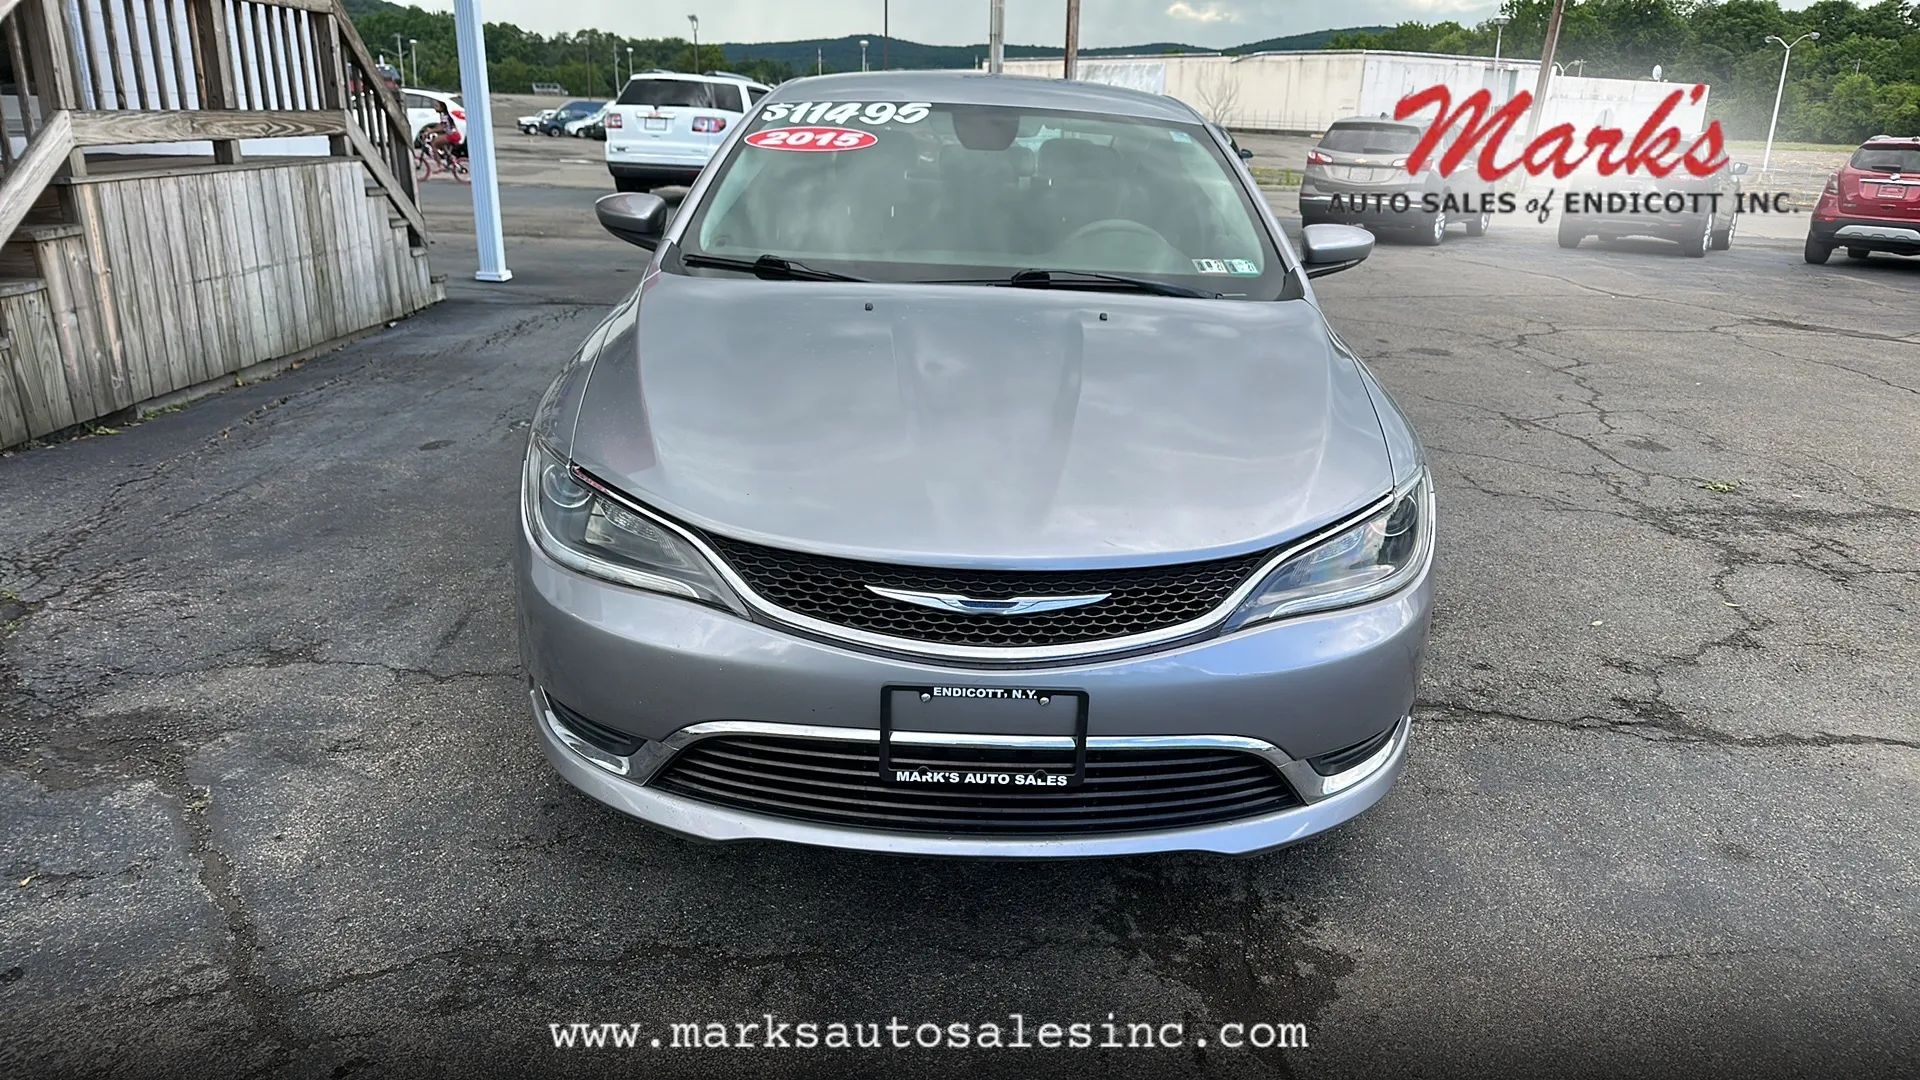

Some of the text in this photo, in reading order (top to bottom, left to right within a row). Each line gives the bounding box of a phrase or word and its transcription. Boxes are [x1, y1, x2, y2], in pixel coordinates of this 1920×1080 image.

[762, 102, 934, 125] $11495
[758, 131, 865, 147] 2015
[1012, 688, 1038, 699] N.Y.
[896, 771, 1068, 786] MARK'S AUTO SALES
